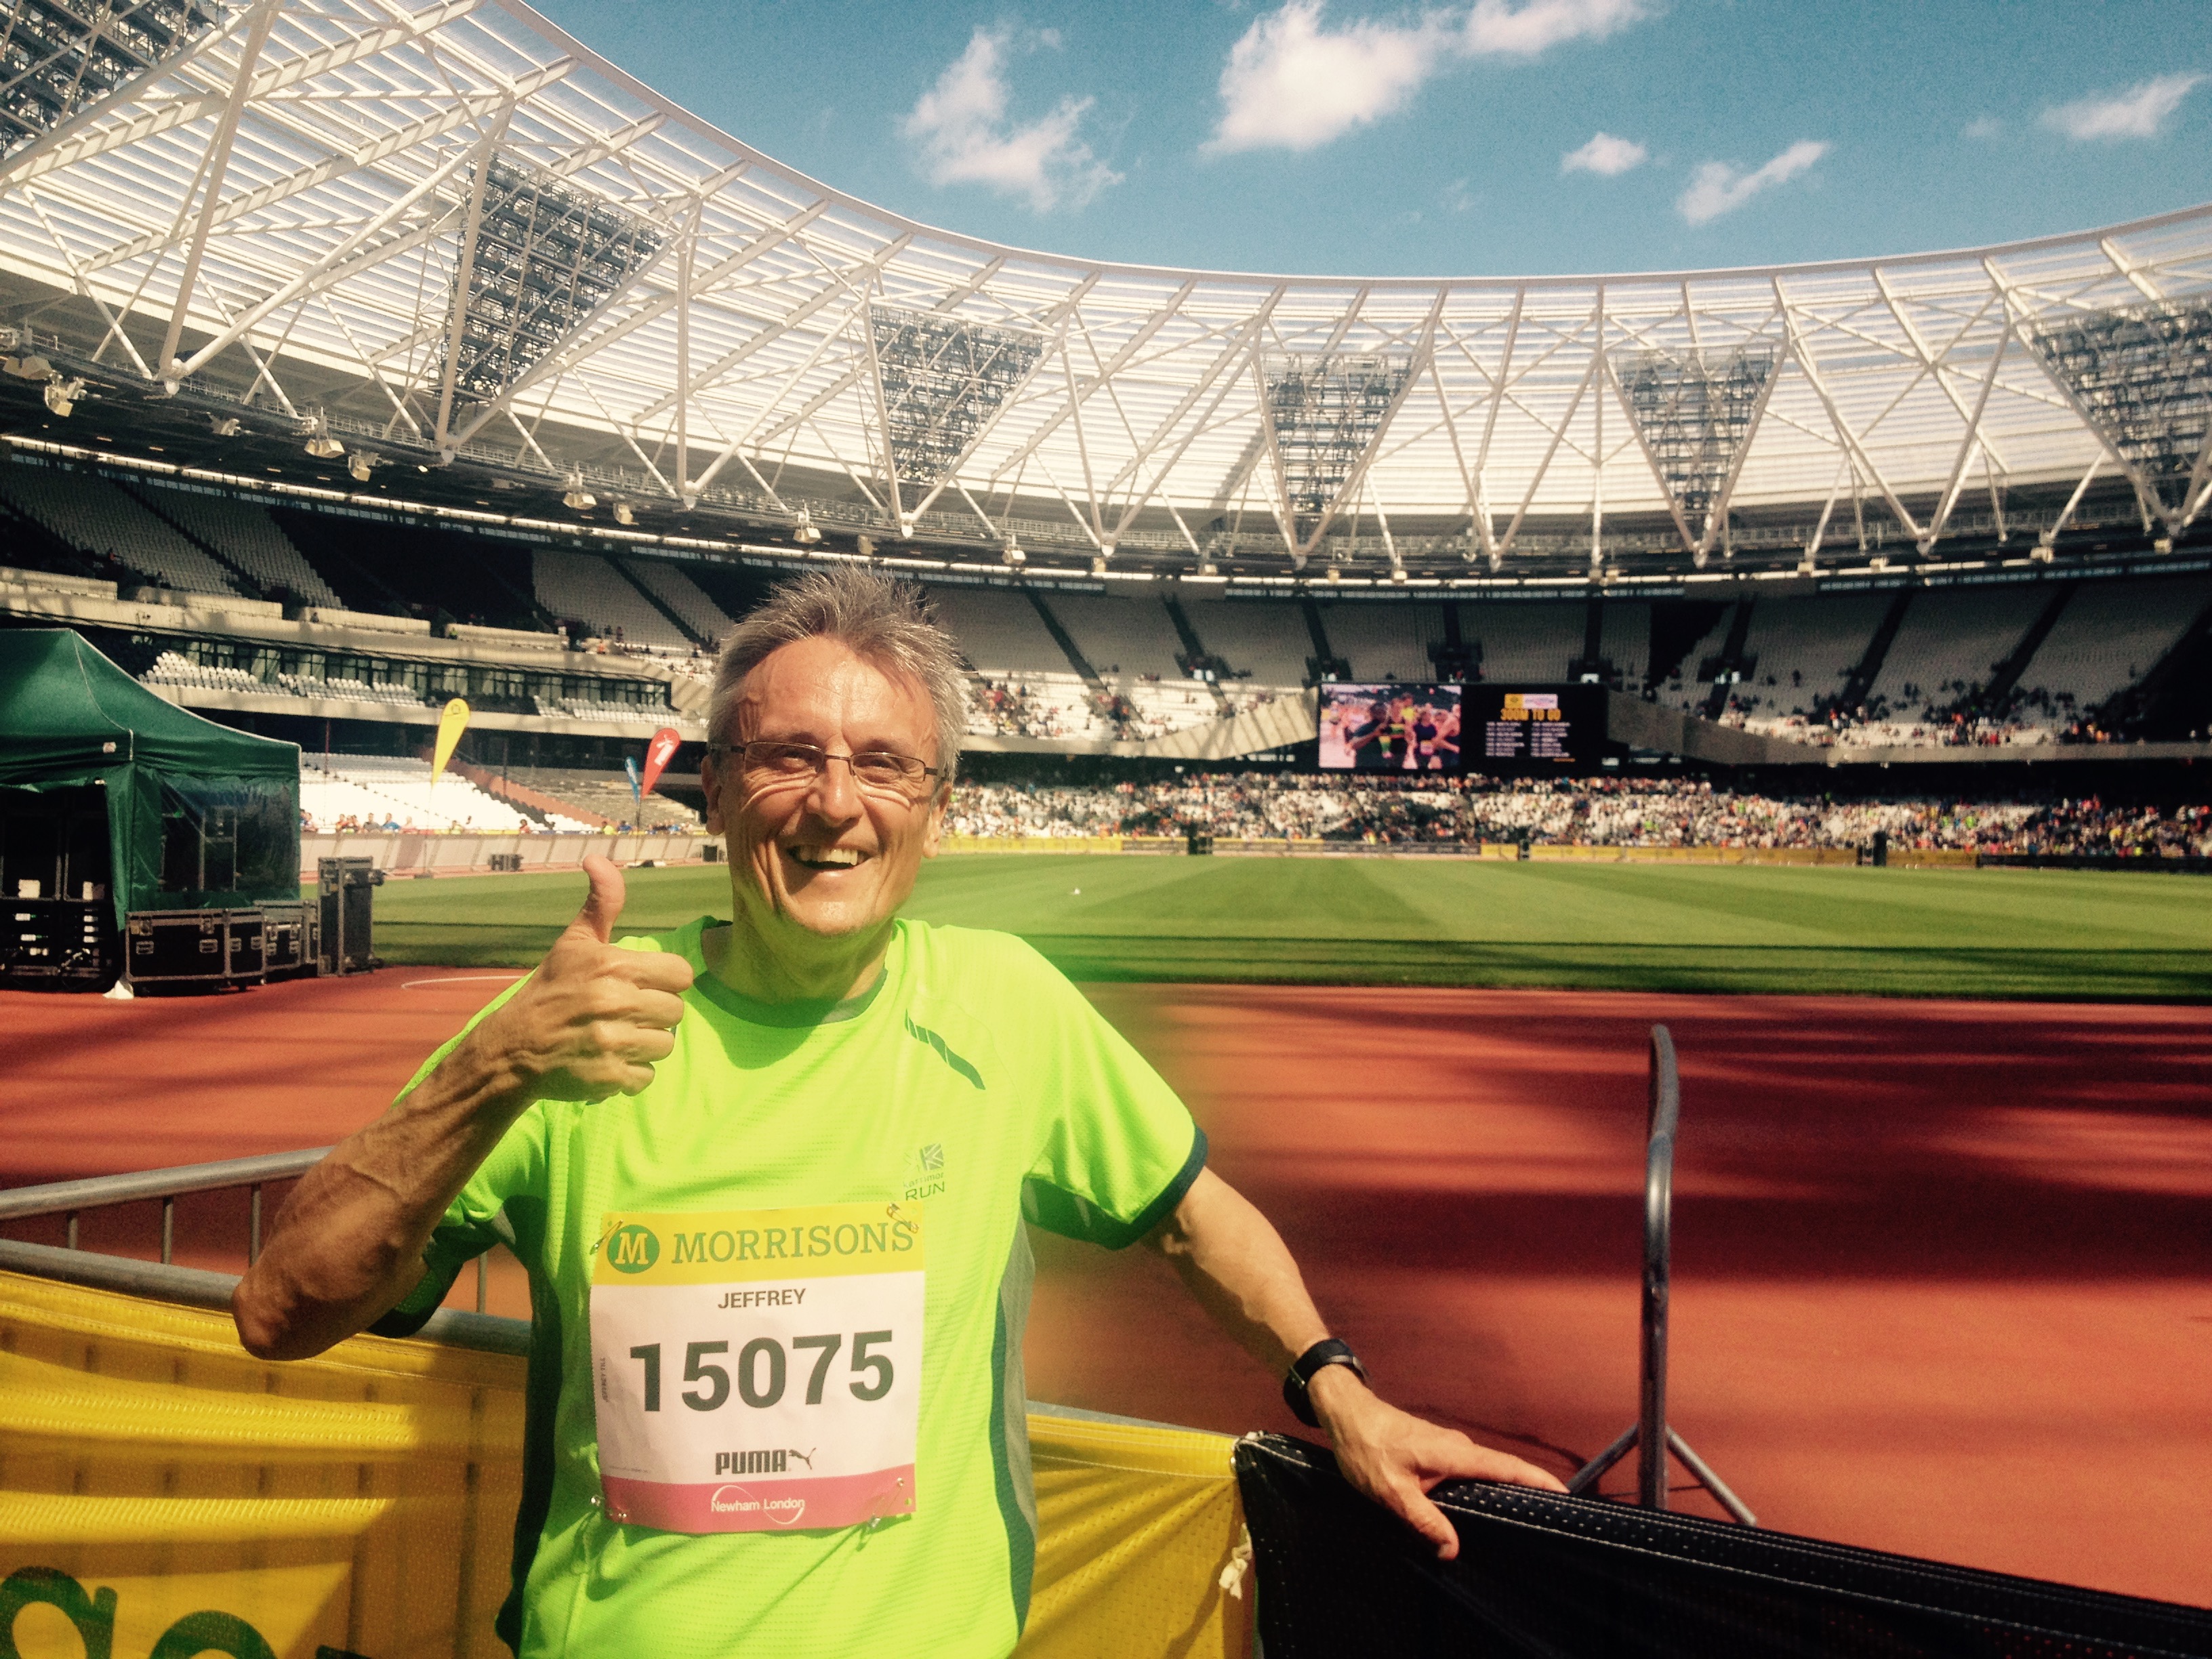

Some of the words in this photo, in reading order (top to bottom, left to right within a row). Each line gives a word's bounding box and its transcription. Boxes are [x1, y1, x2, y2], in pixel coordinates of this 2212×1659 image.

[905, 1181, 945, 1201] RUN
[614, 1231, 649, 1265] M
[671, 1221, 914, 1263] MORRISONS
[718, 1288, 806, 1309] JEFFREY
[629, 1330, 895, 1412] 15075
[715, 1449, 787, 1475] PUMA
[711, 1500, 760, 1512] Newham
[763, 1497, 806, 1510] London
